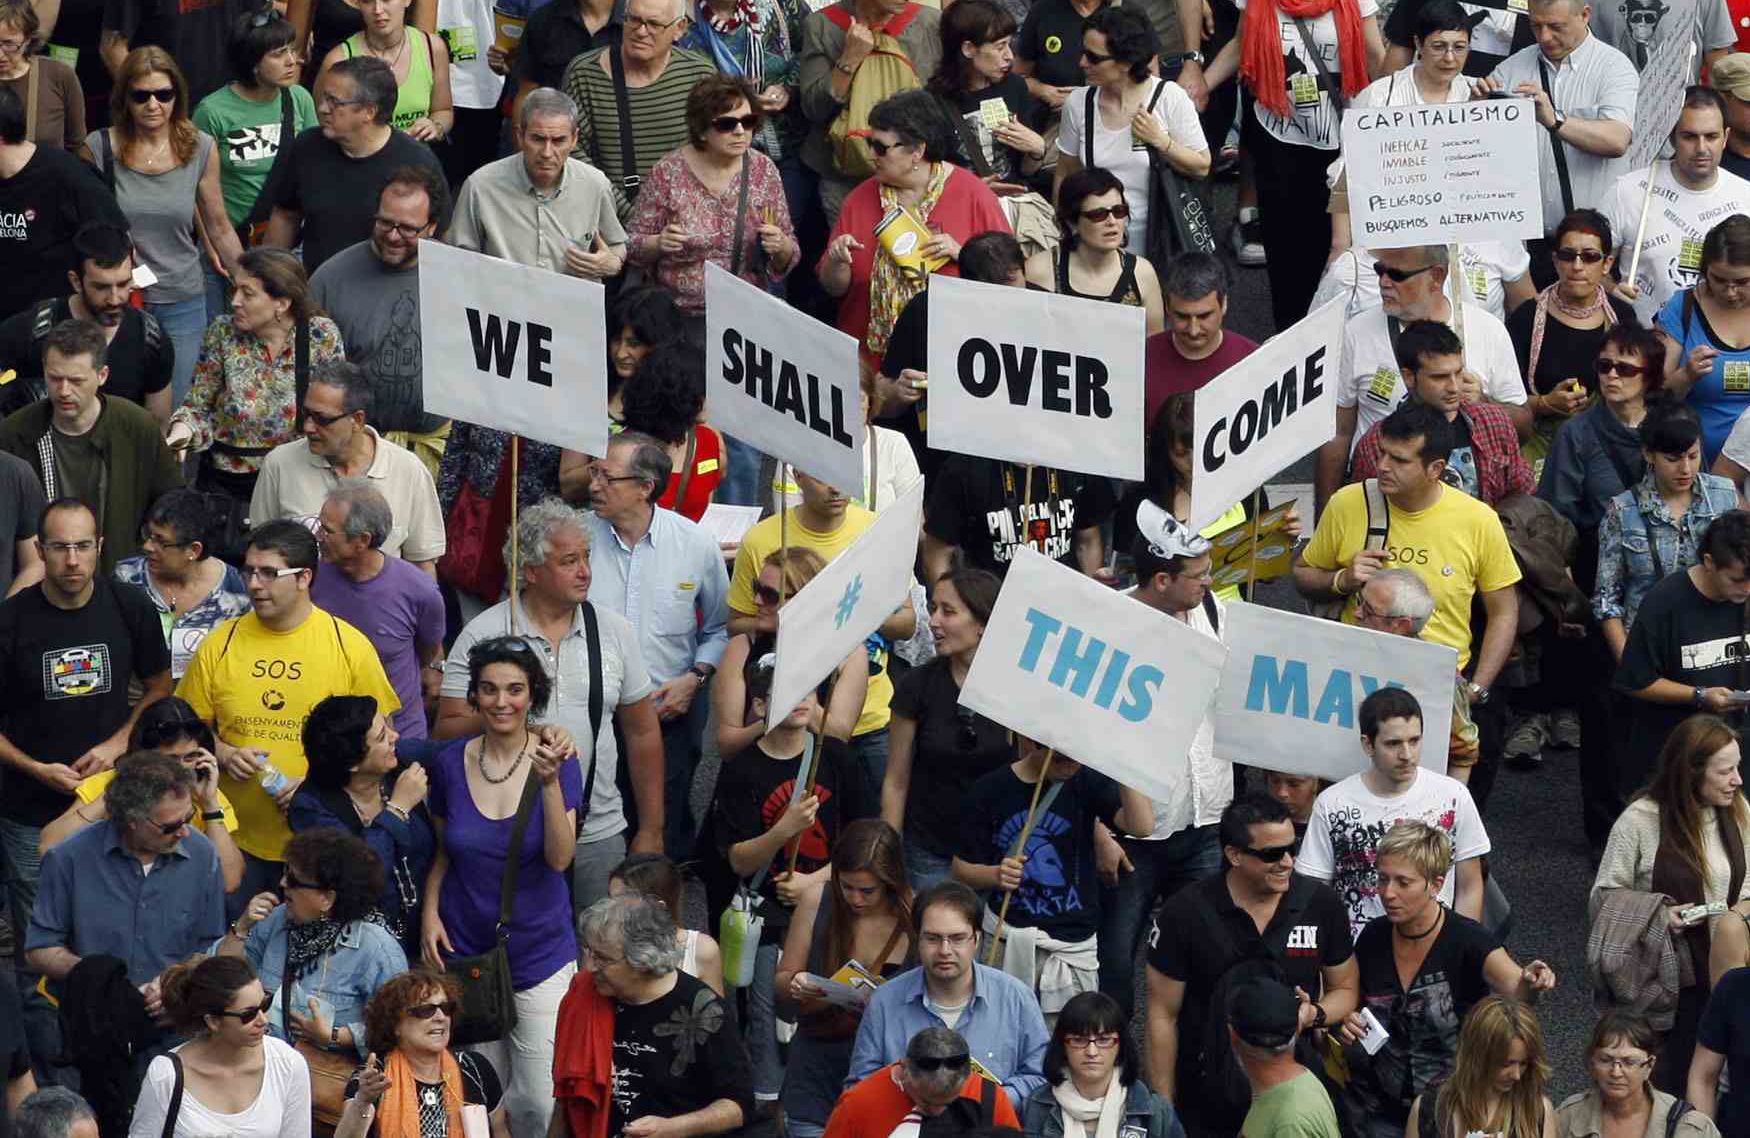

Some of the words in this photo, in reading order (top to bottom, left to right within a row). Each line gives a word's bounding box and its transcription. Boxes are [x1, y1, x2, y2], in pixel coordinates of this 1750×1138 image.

[1356, 104, 1520, 132] CAPITALISMO
[1379, 139, 1430, 154] INEFICAZ
[1382, 156, 1427, 171] INVIABLE
[1367, 192, 1443, 213] PELIGROSO
[1365, 217, 1428, 235] BUSQUEMOS
[1438, 209, 1525, 226] ALTERNATIVAS
[464, 307, 553, 388] WE
[722, 328, 854, 449] SHALL
[957, 337, 1113, 419] OVER
[1202, 344, 1327, 473] COME
[1389, 546, 1429, 565] SOS
[251, 659, 303, 681] SOS
[1017, 608, 1165, 723] THIS
